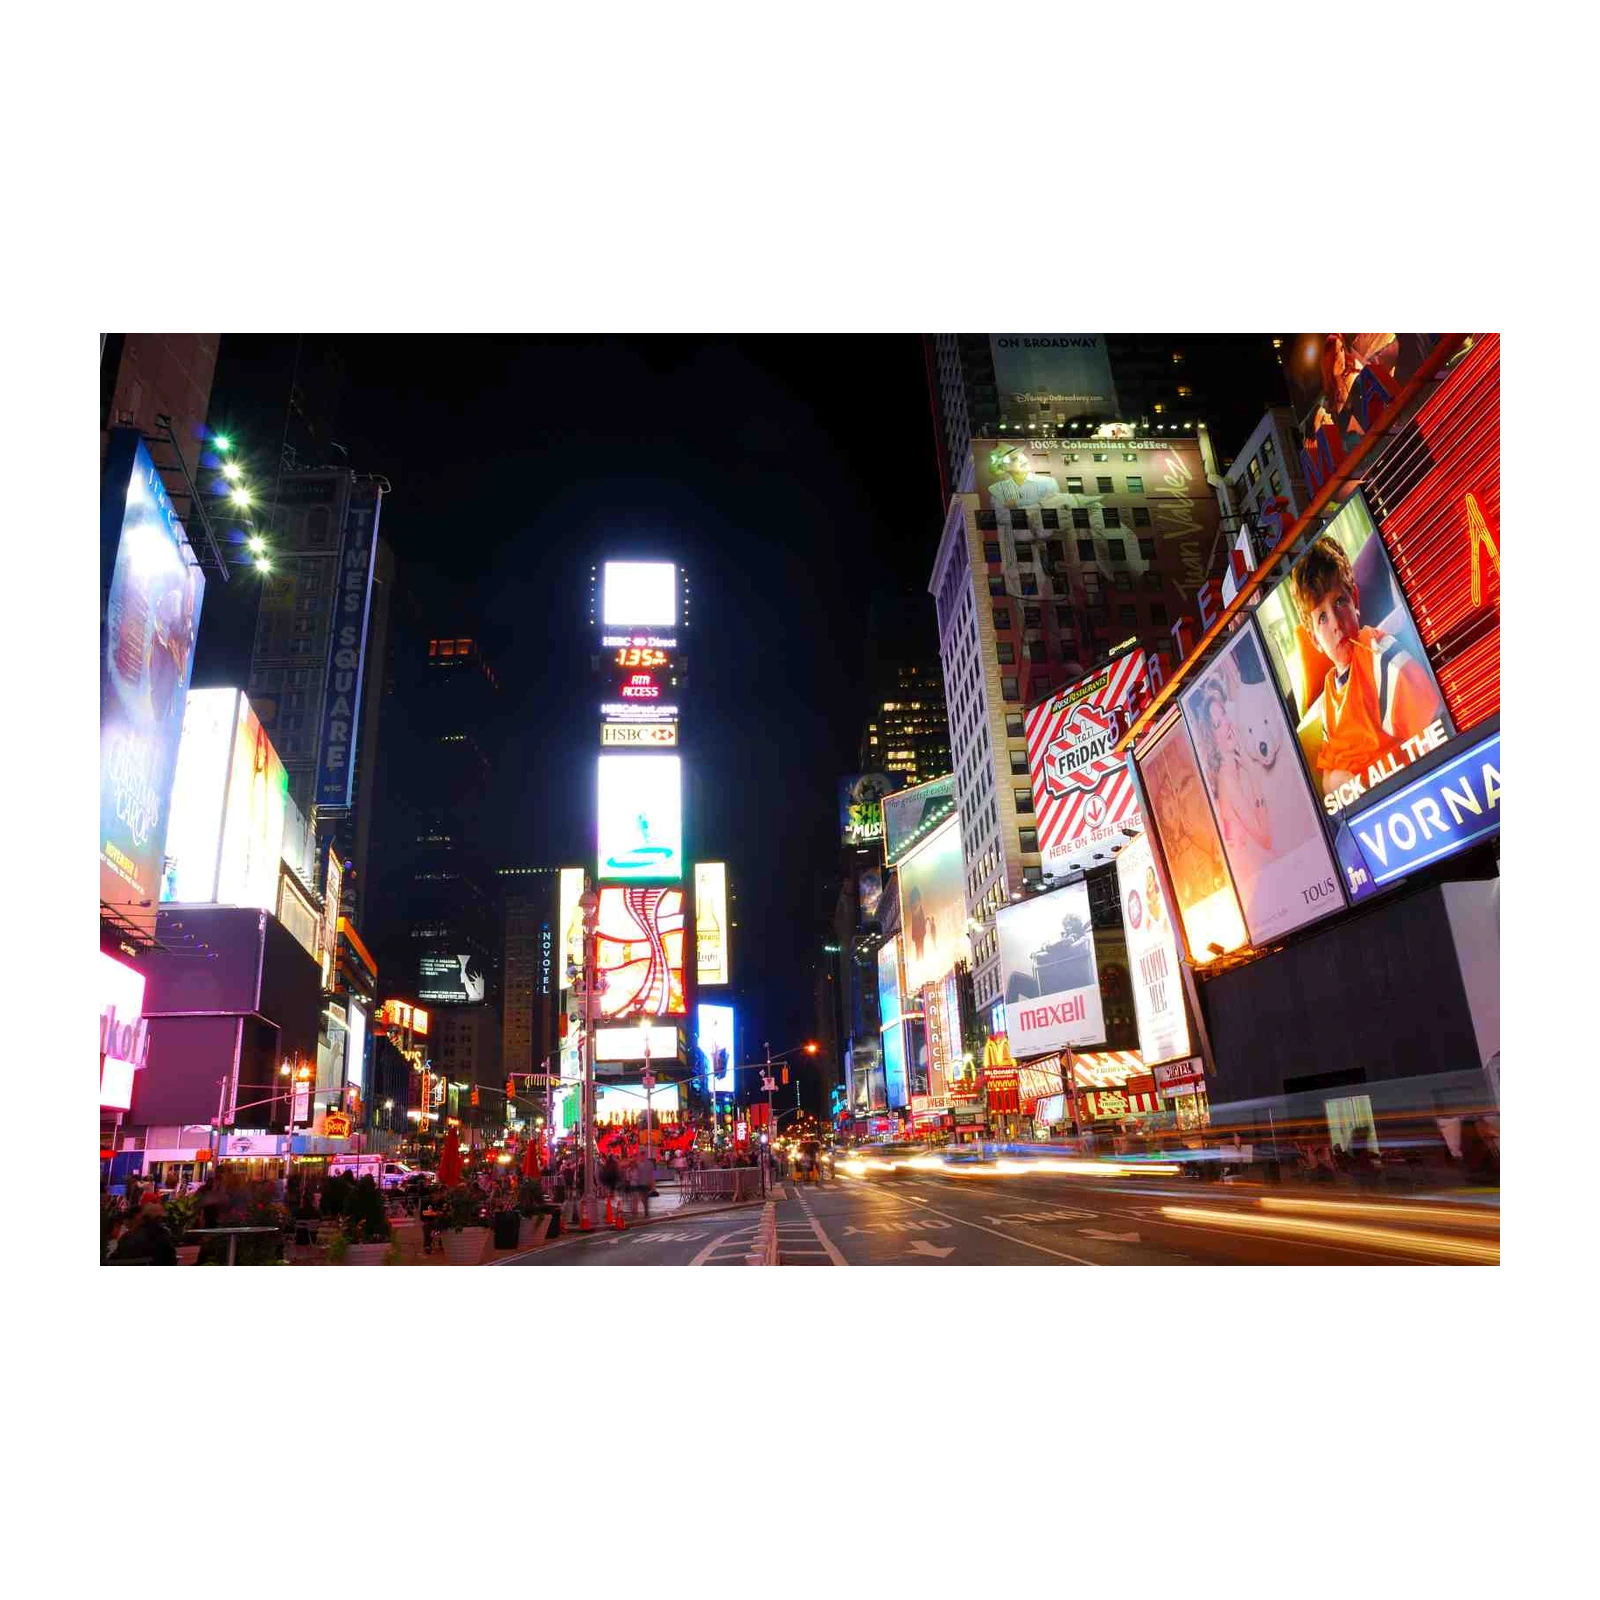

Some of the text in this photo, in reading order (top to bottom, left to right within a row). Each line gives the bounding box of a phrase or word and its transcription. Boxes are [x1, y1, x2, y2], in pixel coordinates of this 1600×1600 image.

[998, 337, 1099, 348] ON BROADWAY
[1030, 440, 1168, 450] 100% Colombian Coffee
[327, 508, 373, 769] TIMES SQUARE
[622, 687, 660, 697] ACCESS
[604, 728, 649, 741] HSBC
[1324, 718, 1449, 815] SICK ALL THE
[1049, 814, 1144, 860] HERE ON 46TH STRE
[1302, 877, 1335, 904] TOUS
[542, 932, 551, 994] NOVOTEL
[928, 991, 942, 1071] PALACE
[1020, 994, 1086, 1032] maxell
